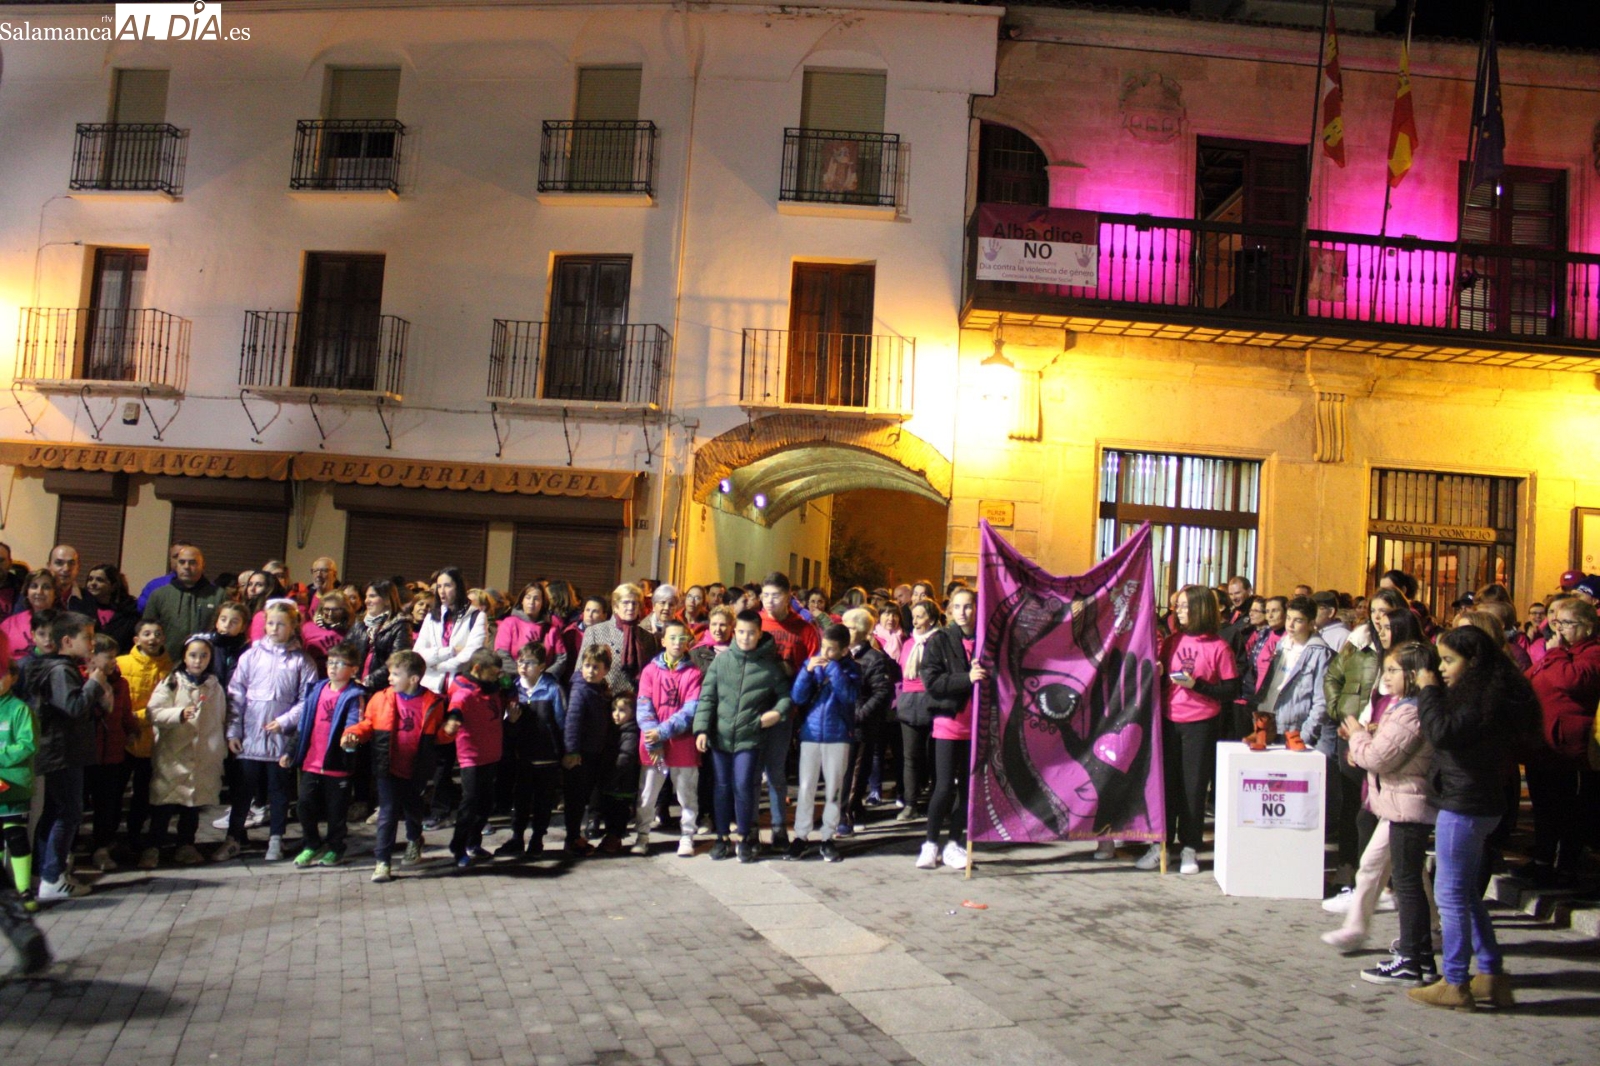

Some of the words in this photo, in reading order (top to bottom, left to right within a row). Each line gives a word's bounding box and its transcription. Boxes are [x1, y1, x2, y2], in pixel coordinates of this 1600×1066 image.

[993, 223, 1038, 240] Alba
[1043, 226, 1083, 243] dice
[1023, 242, 1053, 259] NO
[1017, 264, 1024, 272] la
[1025, 265, 1057, 274] violencia
[1058, 267, 1068, 275] de
[28, 446, 136, 466] JOYERIA
[153, 449, 236, 471] ANGEL
[318, 461, 488, 485] RELOJERIA
[505, 472, 600, 491] ANGEL
[1386, 524, 1416, 535] CASA
[1420, 526, 1434, 536] DE
[1439, 528, 1491, 540] CONCEJO
[1243, 783, 1270, 793] ALBA
[1262, 794, 1285, 802] DICE
[1262, 803, 1286, 816] NO
